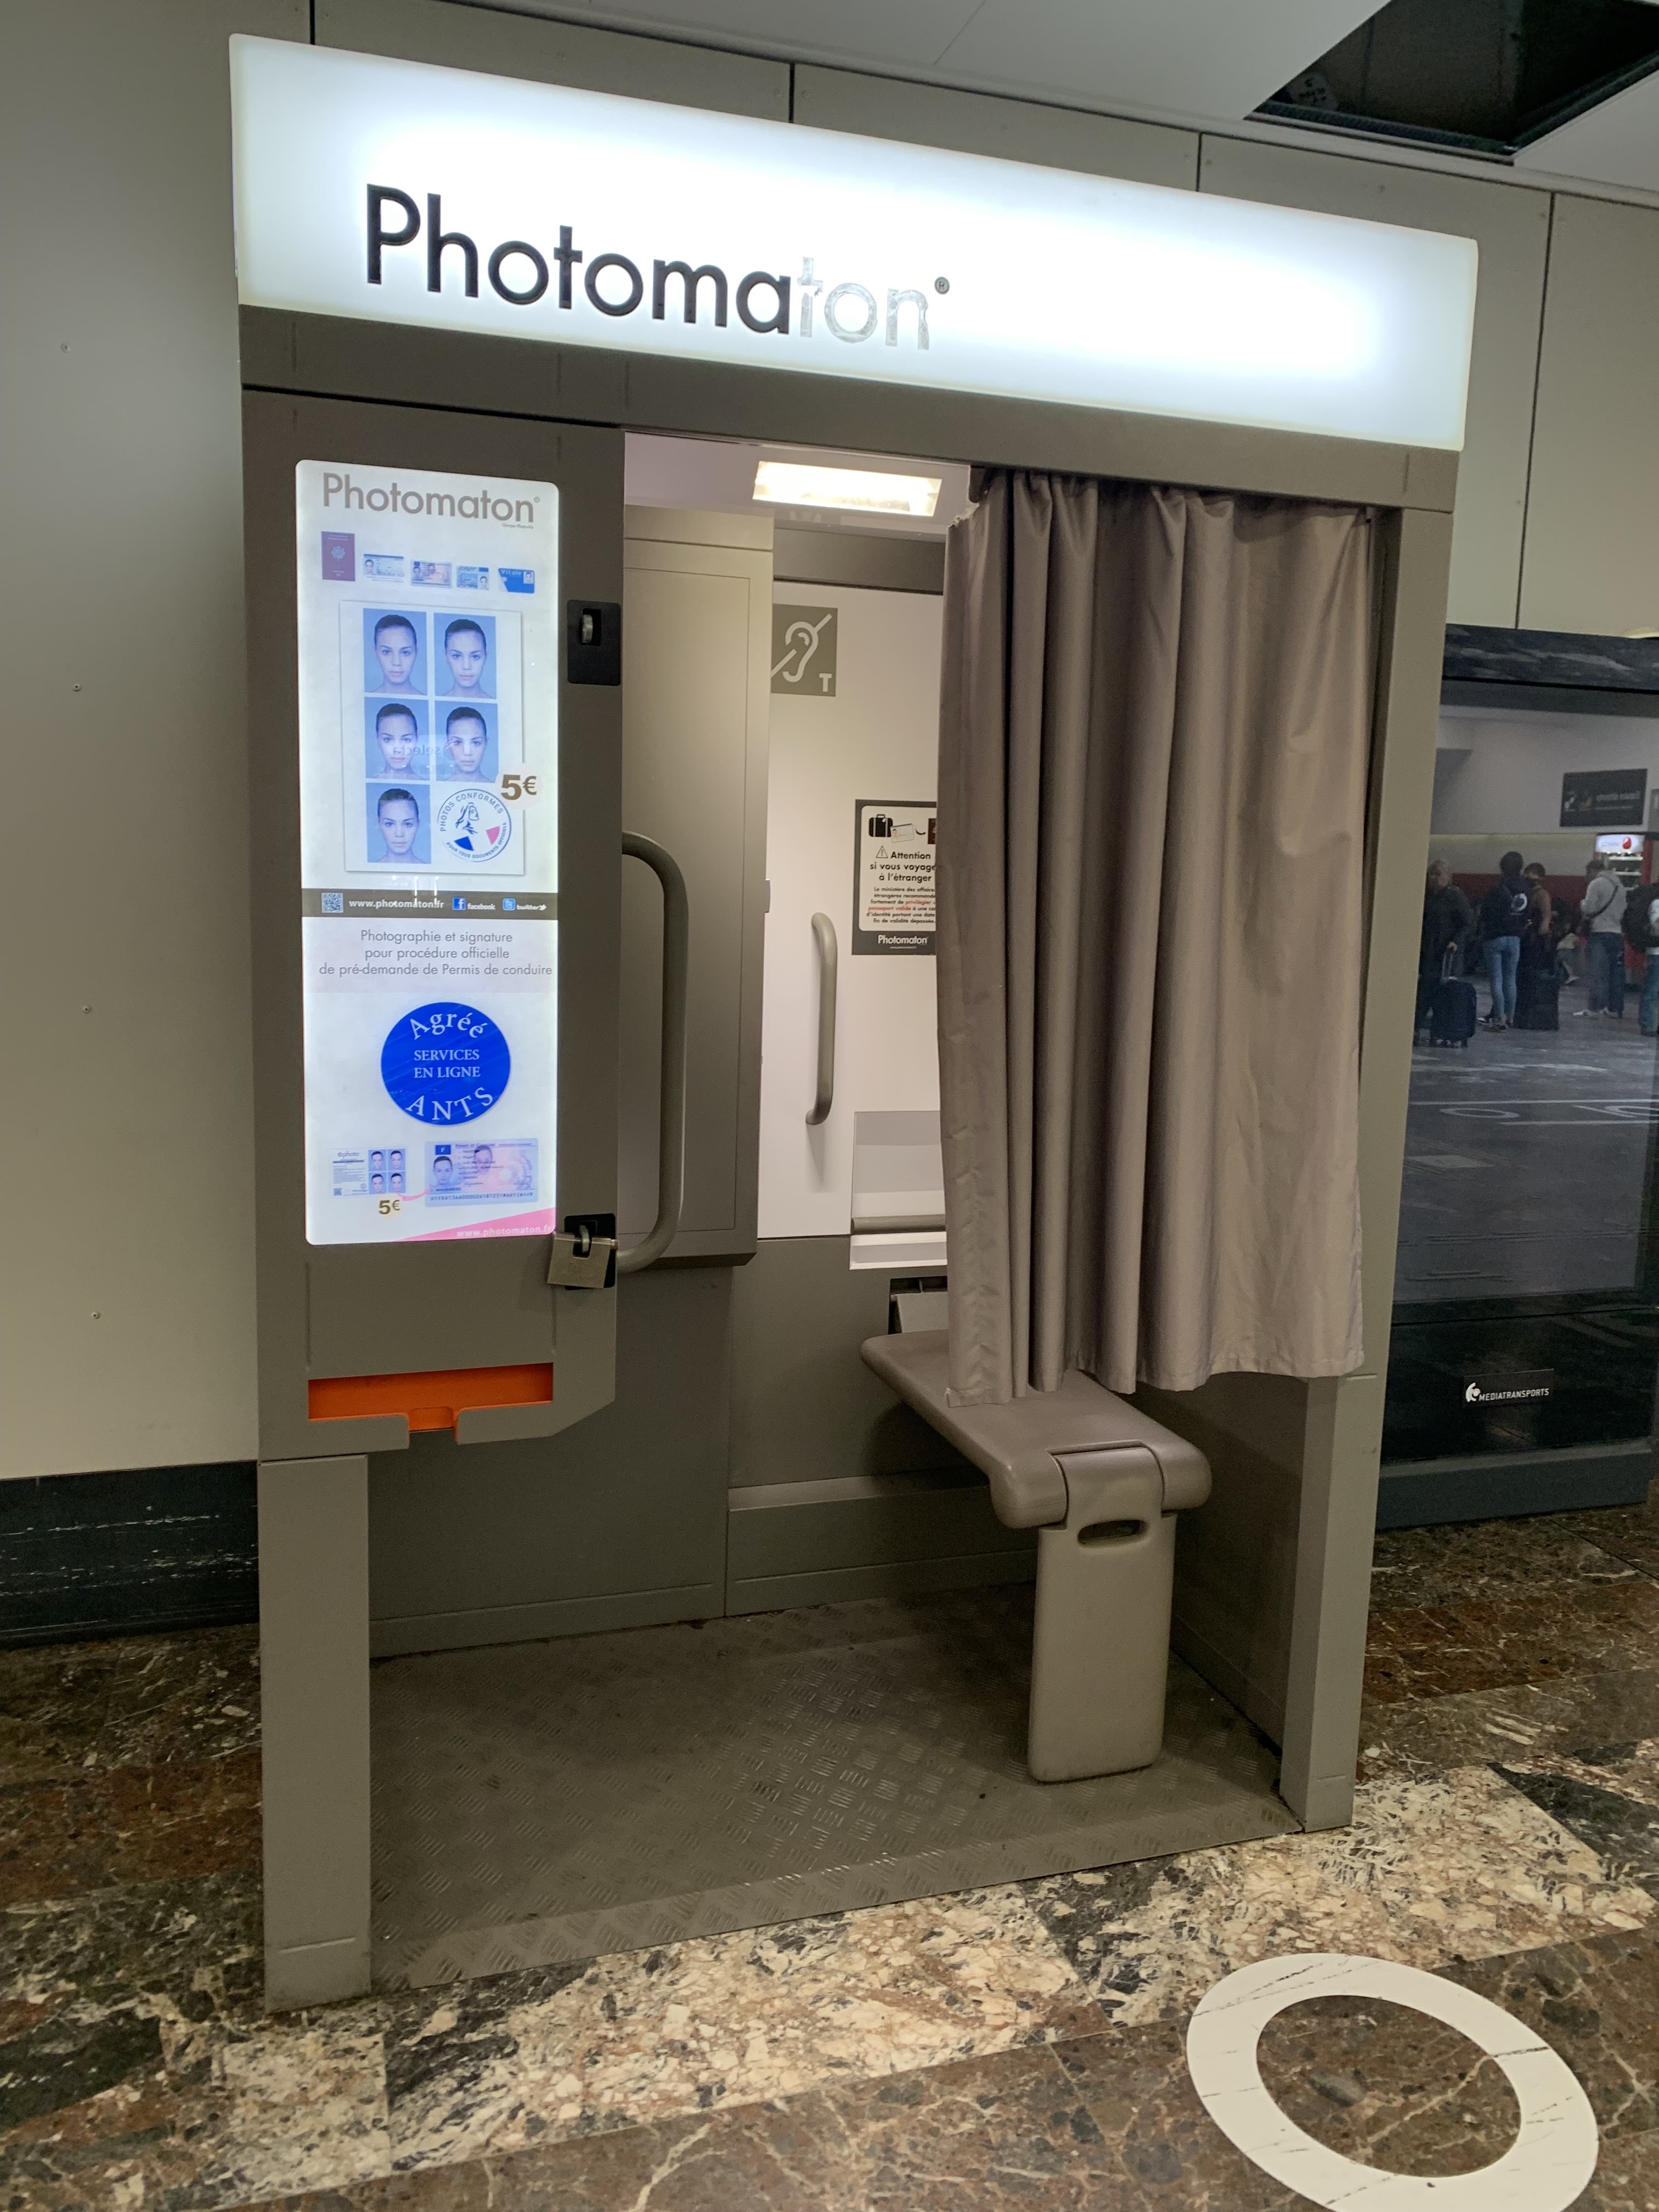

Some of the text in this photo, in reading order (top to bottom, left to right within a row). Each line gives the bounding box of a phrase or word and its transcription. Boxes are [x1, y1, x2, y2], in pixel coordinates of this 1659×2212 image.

[500, 774, 537, 801] 5€
[440, 792, 504, 832] PHOTOS CONFORMES
[446, 842, 459, 852] POUR
[890, 851, 930, 859] Attention
[904, 864, 936, 872] voyage
[888, 873, 932, 883] l'étranger
[348, 899, 445, 909] www.photomaton.fr
[361, 929, 513, 945] Photographie et signature
[878, 934, 928, 944] Photomaton
[365, 946, 510, 961] pour procédure officielle
[319, 962, 552, 978] de pré-demande de Permis de conduire
[410, 1012, 488, 1040] Agréé
[414, 1049, 480, 1061] SERVICES
[414, 1066, 481, 1078] EN LIGNE
[405, 1087, 493, 1120] ANTS
[379, 1199, 400, 1215] 5€
[456, 1225, 551, 1237] www.photomaton.fr
[1479, 1388, 1549, 1401] MEDIATRANSPORTS
